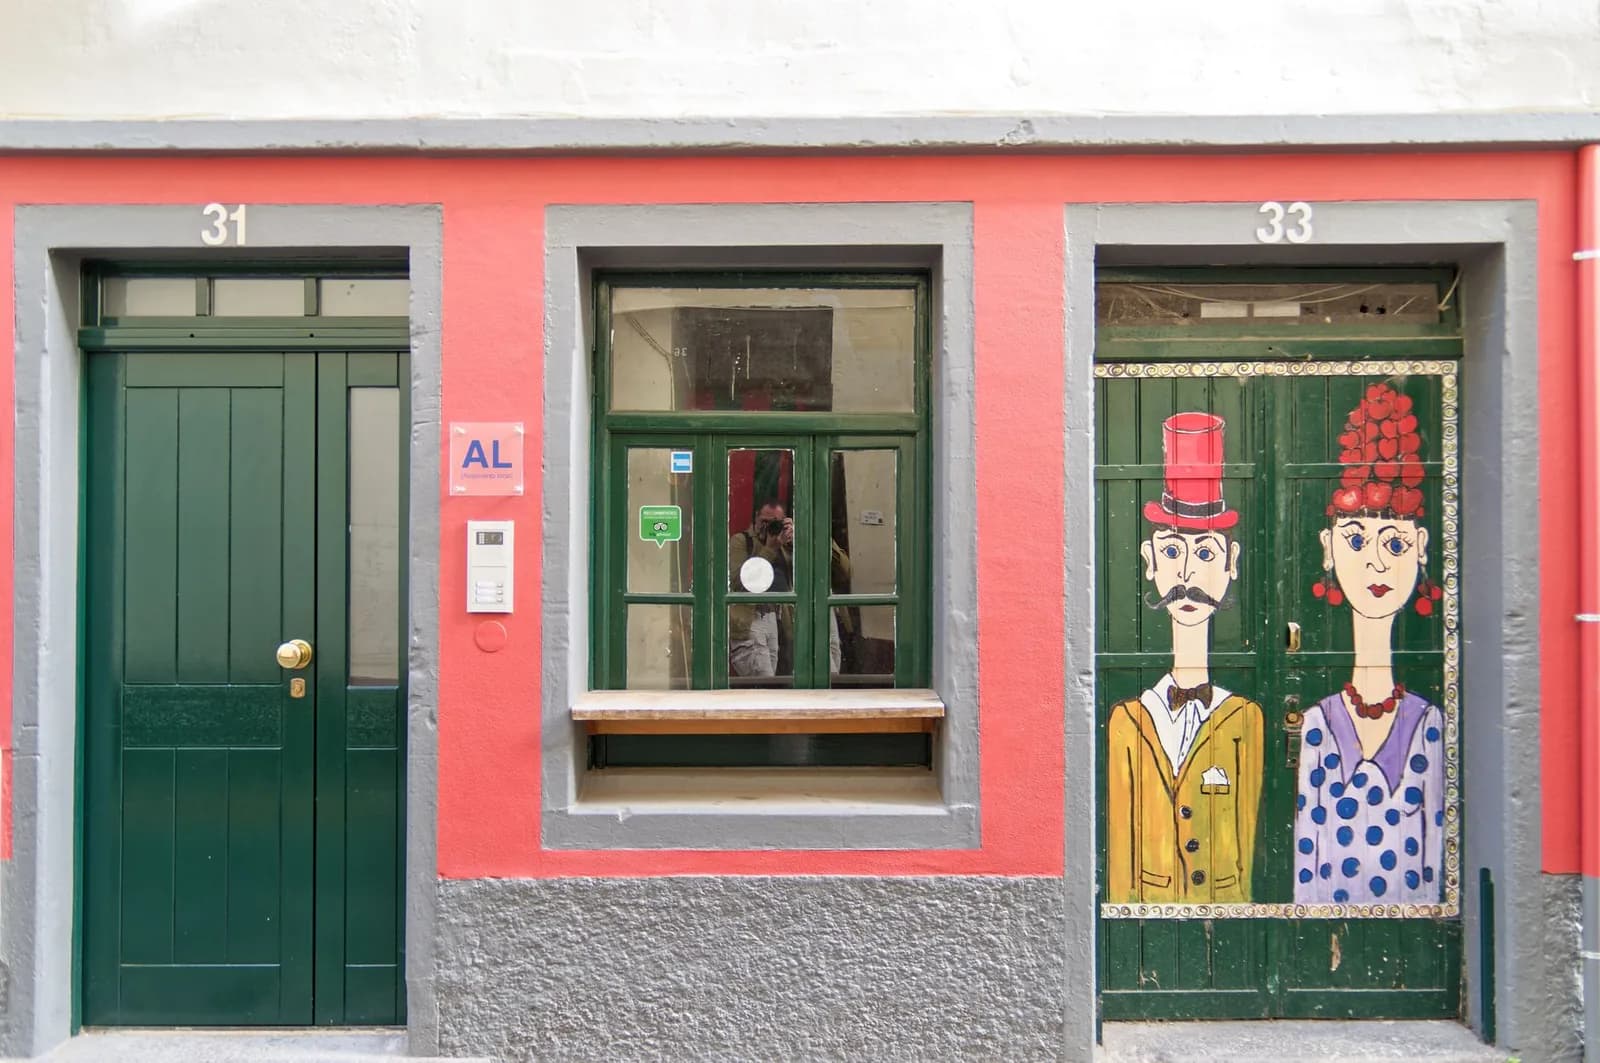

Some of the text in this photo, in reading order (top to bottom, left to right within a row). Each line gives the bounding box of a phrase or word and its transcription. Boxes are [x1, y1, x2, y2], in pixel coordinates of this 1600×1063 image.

[201, 203, 246, 246] 31
[1256, 201, 1313, 244] 33
[462, 439, 513, 469] AL
